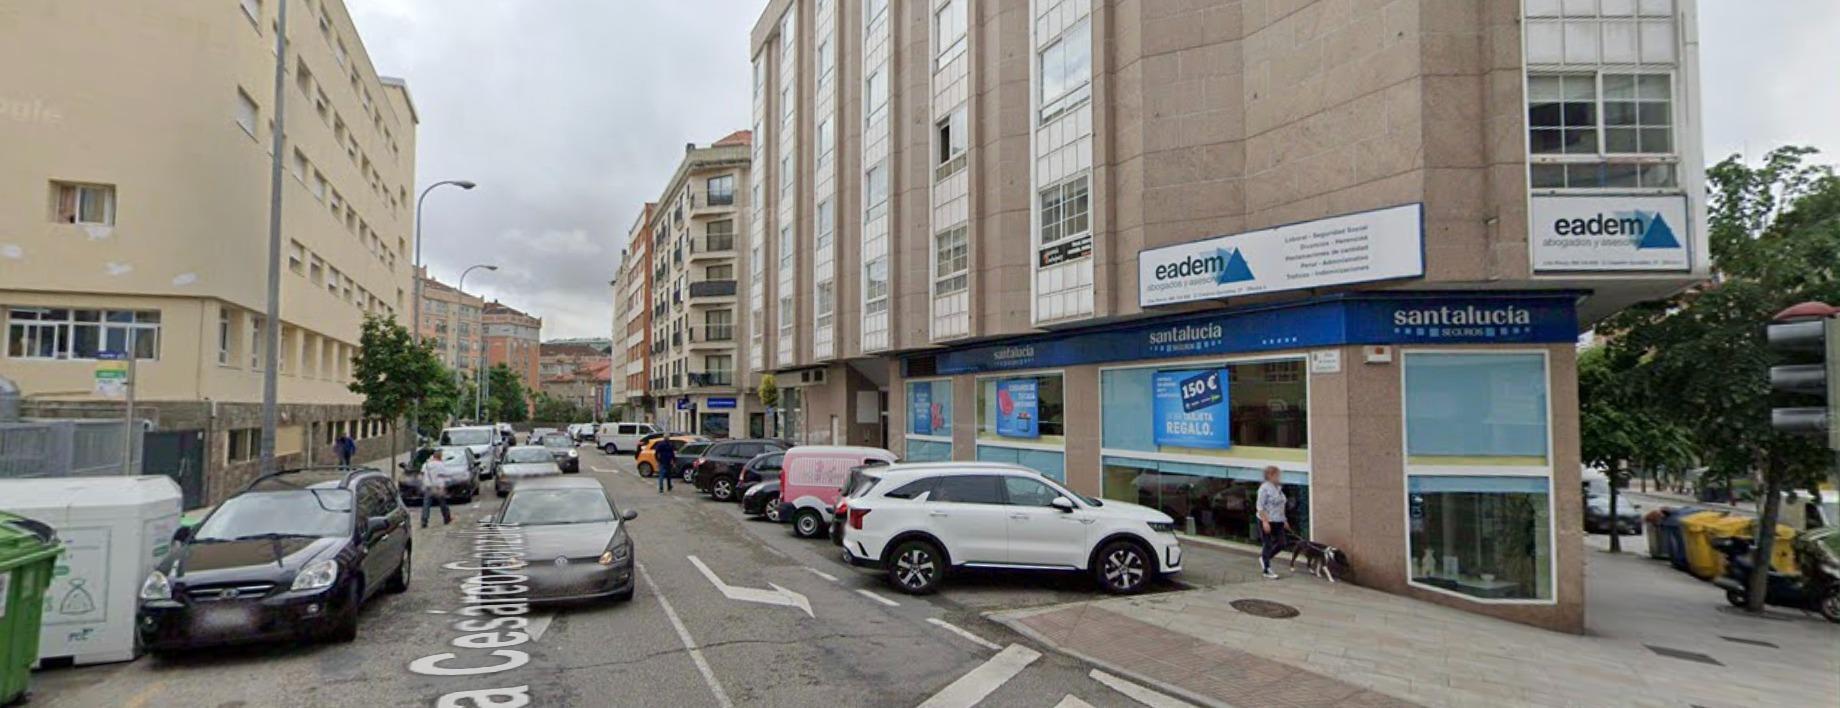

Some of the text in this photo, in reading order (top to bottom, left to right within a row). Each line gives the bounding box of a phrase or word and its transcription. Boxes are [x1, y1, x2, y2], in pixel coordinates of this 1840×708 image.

[1554, 212, 1645, 236] eadem
[1543, 237, 1592, 249] abogados
[1593, 239, 1600, 249] y
[1155, 254, 1225, 281] eadem
[1147, 280, 1183, 292] abogados
[1393, 304, 1531, 325] santalucía
[1149, 321, 1223, 345] santalucía
[1441, 327, 1484, 337] SEGUROS
[1182, 379, 1206, 400] 150
[1166, 421, 1215, 437] REGALO.
